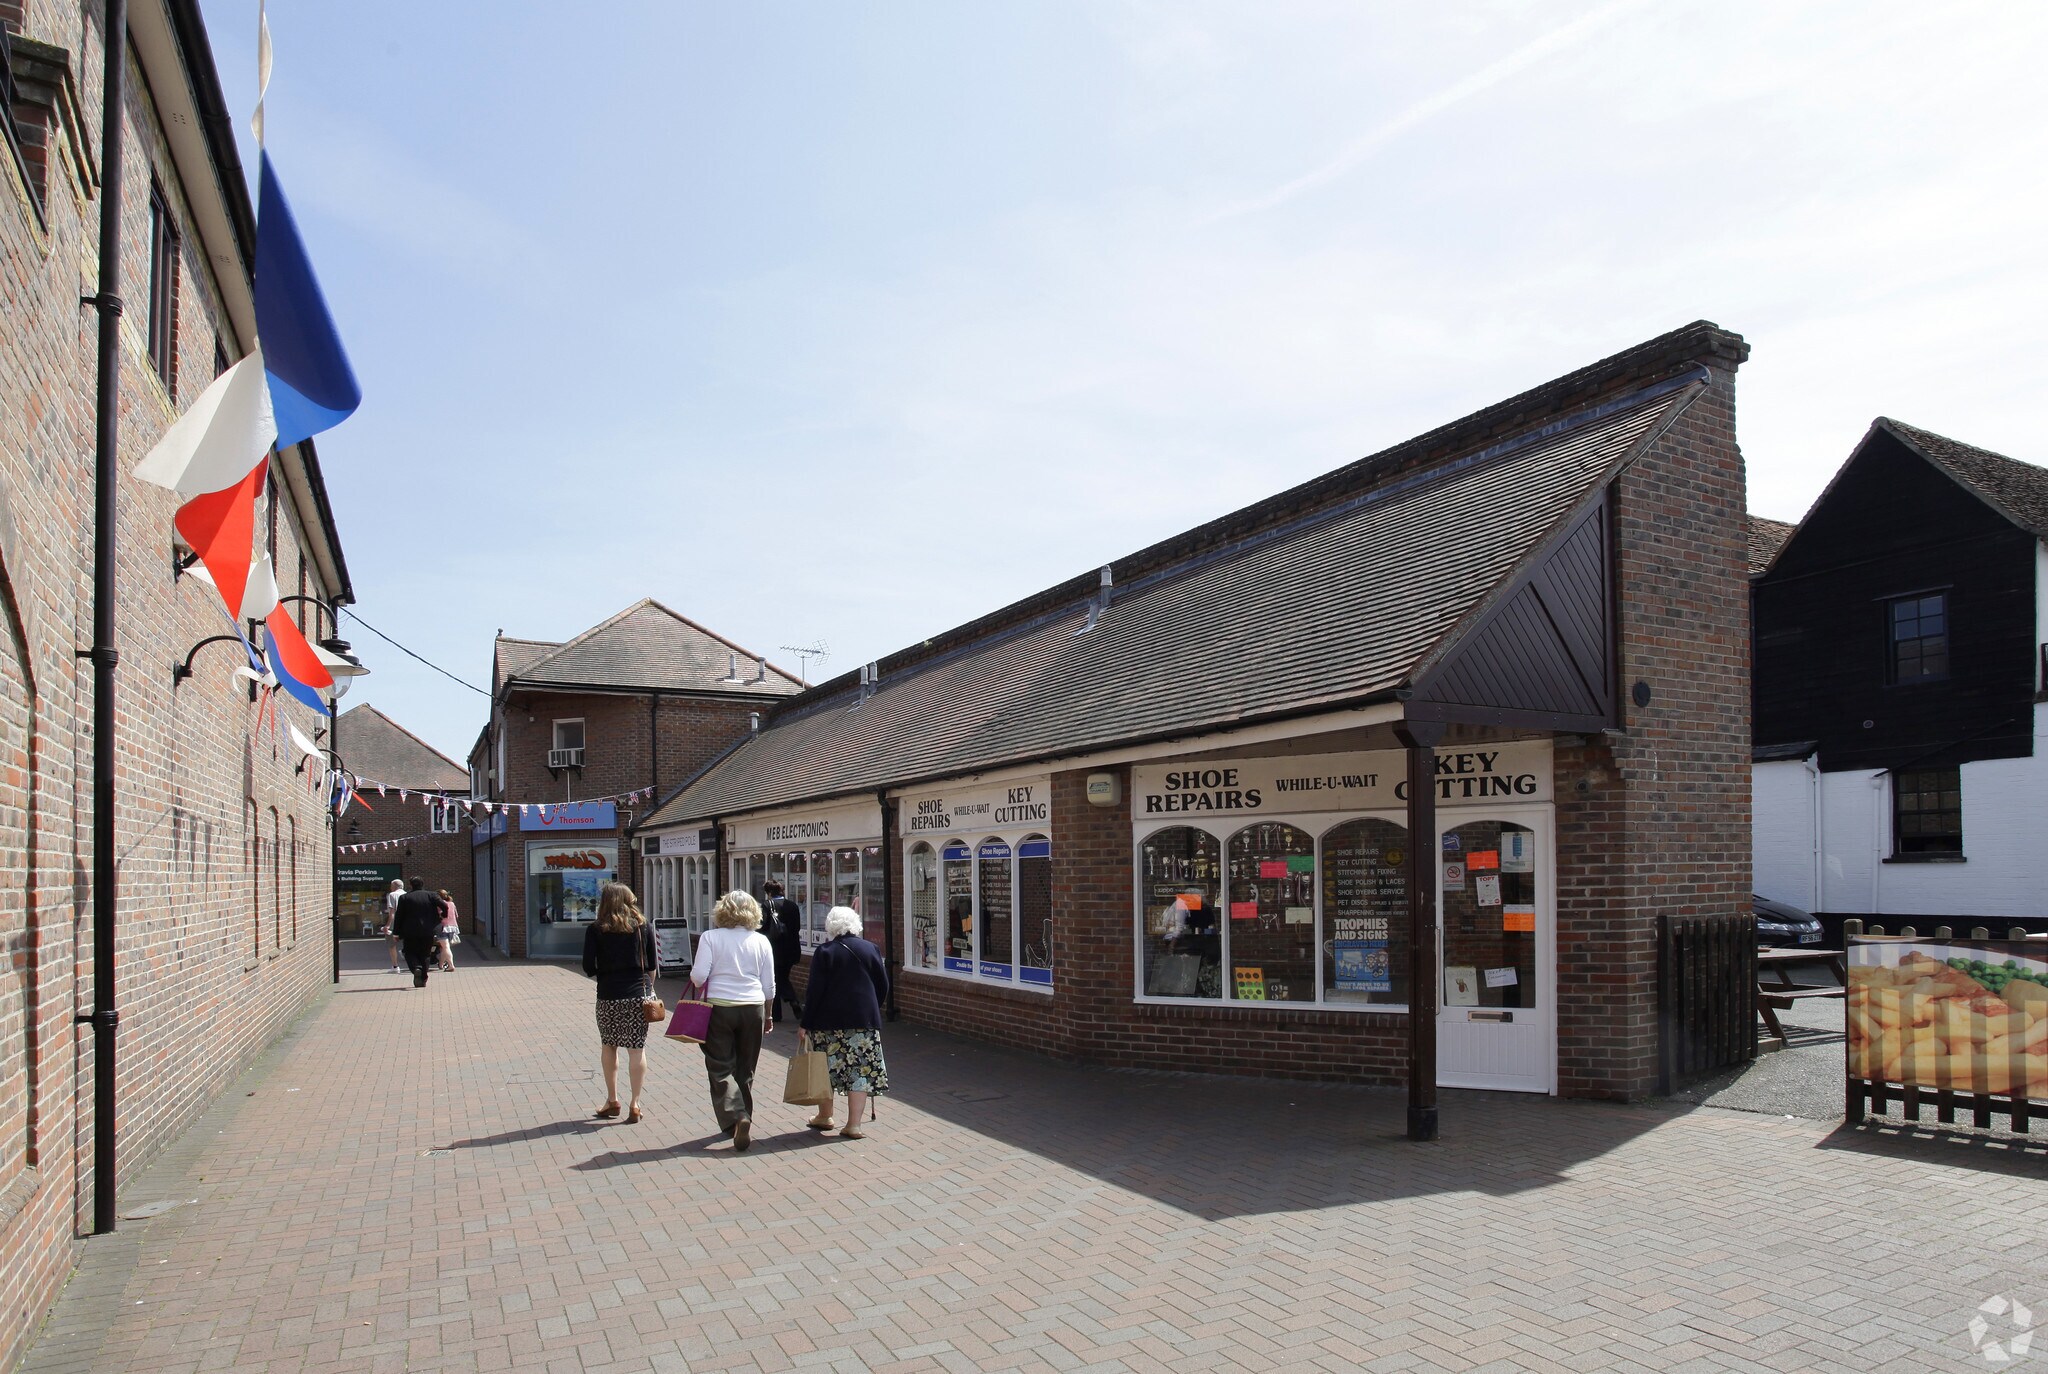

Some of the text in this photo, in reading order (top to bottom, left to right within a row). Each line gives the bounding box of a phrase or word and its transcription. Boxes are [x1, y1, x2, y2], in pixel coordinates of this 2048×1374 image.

[1434, 751, 1499, 775] KEY
[1165, 768, 1239, 791] SHOE
[1275, 773, 1379, 792] WHILE-U-WAIT
[1394, 774, 1537, 800] CTTING
[1008, 786, 1033, 804] KEY
[1145, 789, 1262, 813] REPAIRS
[918, 798, 943, 815] SHOE
[953, 803, 990, 816] WHILE-U-WAIT
[994, 803, 1047, 823] CUTTING
[559, 816, 594, 824] Thomson
[911, 813, 951, 830] REPAIRS
[766, 821, 829, 840] MEB ELECTRONICS
[981, 847, 993, 855] Shoe
[993, 847, 1009, 856] Repairs
[1333, 918, 1388, 930] TROPHIES
[1334, 930, 1389, 940] AND SIGNS
